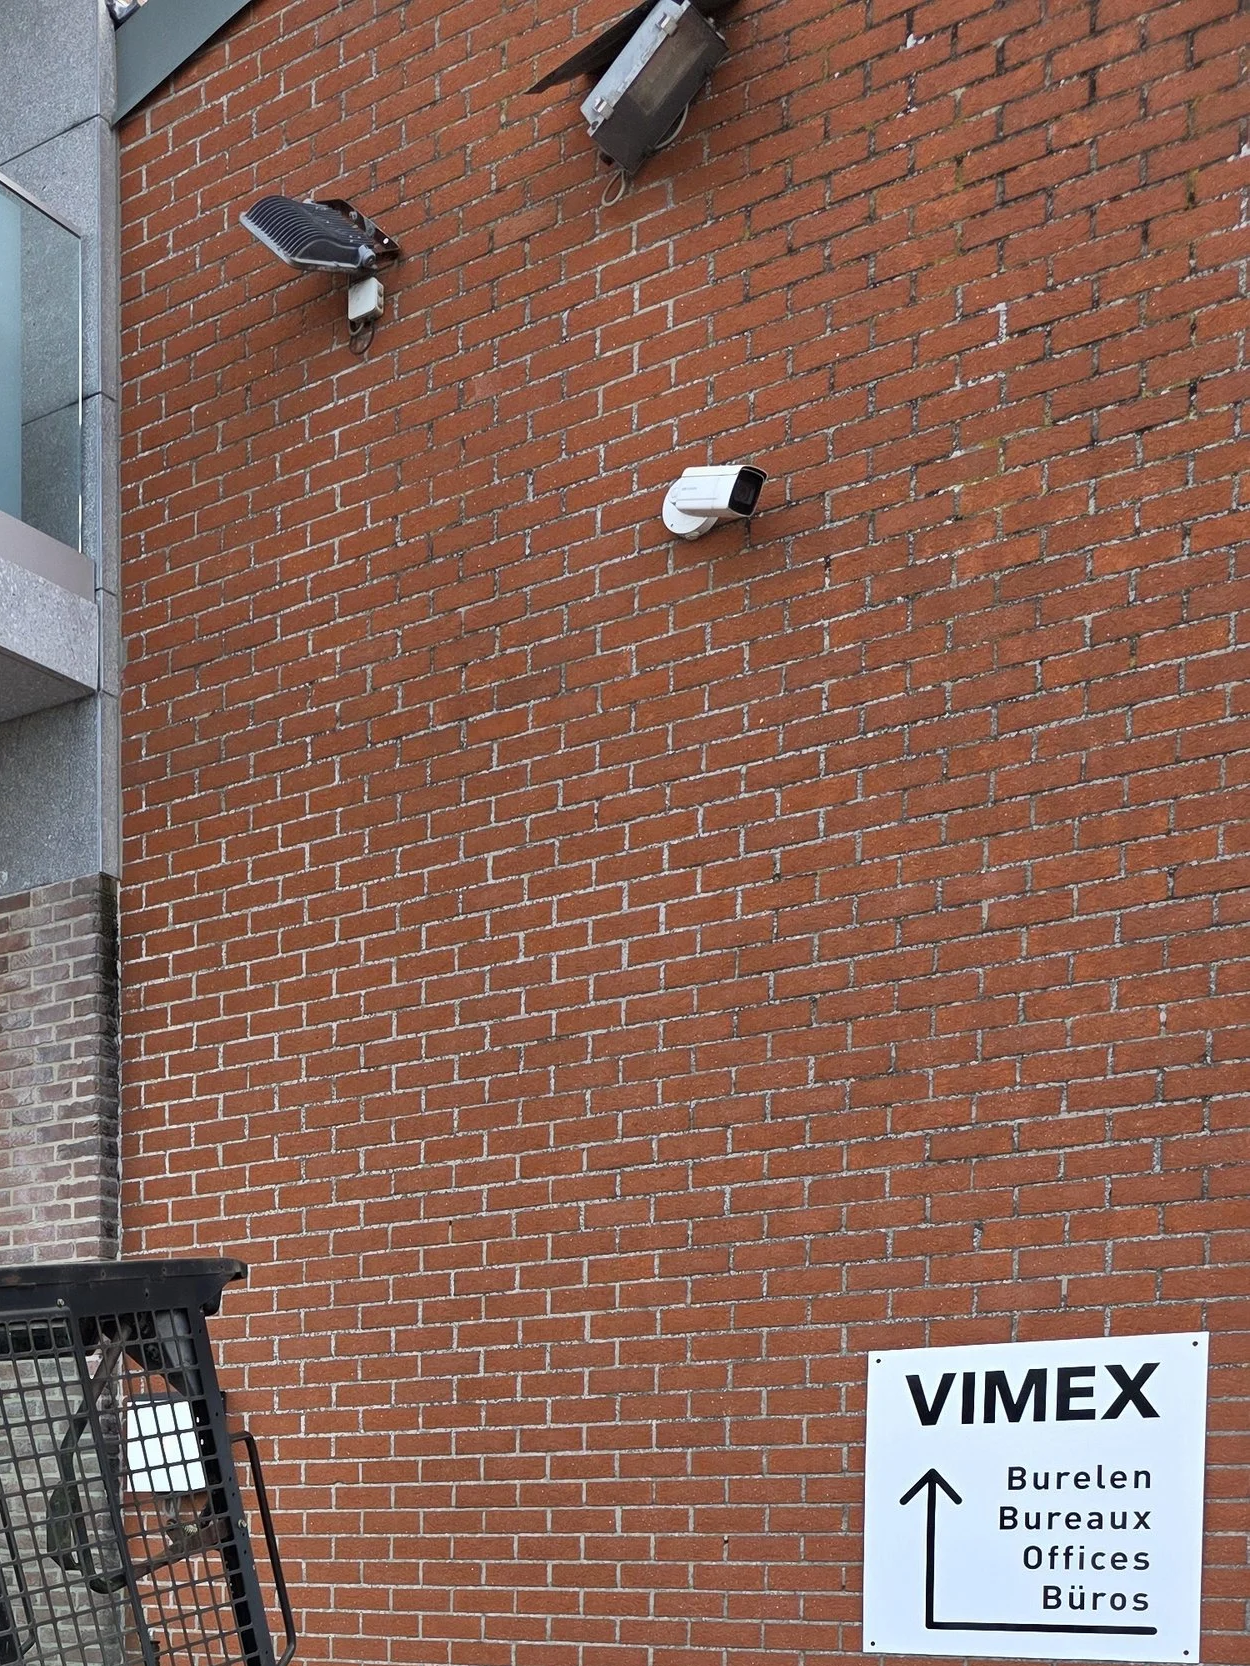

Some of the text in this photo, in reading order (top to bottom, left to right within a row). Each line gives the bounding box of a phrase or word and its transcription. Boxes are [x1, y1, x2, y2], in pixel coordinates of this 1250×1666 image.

[905, 1361, 1161, 1427] VIMEX
[1007, 1464, 1152, 1491] Burelen
[999, 1505, 1152, 1531] Bureaux
[1022, 1545, 1151, 1571] Offices
[1042, 1584, 1150, 1612] Büros
